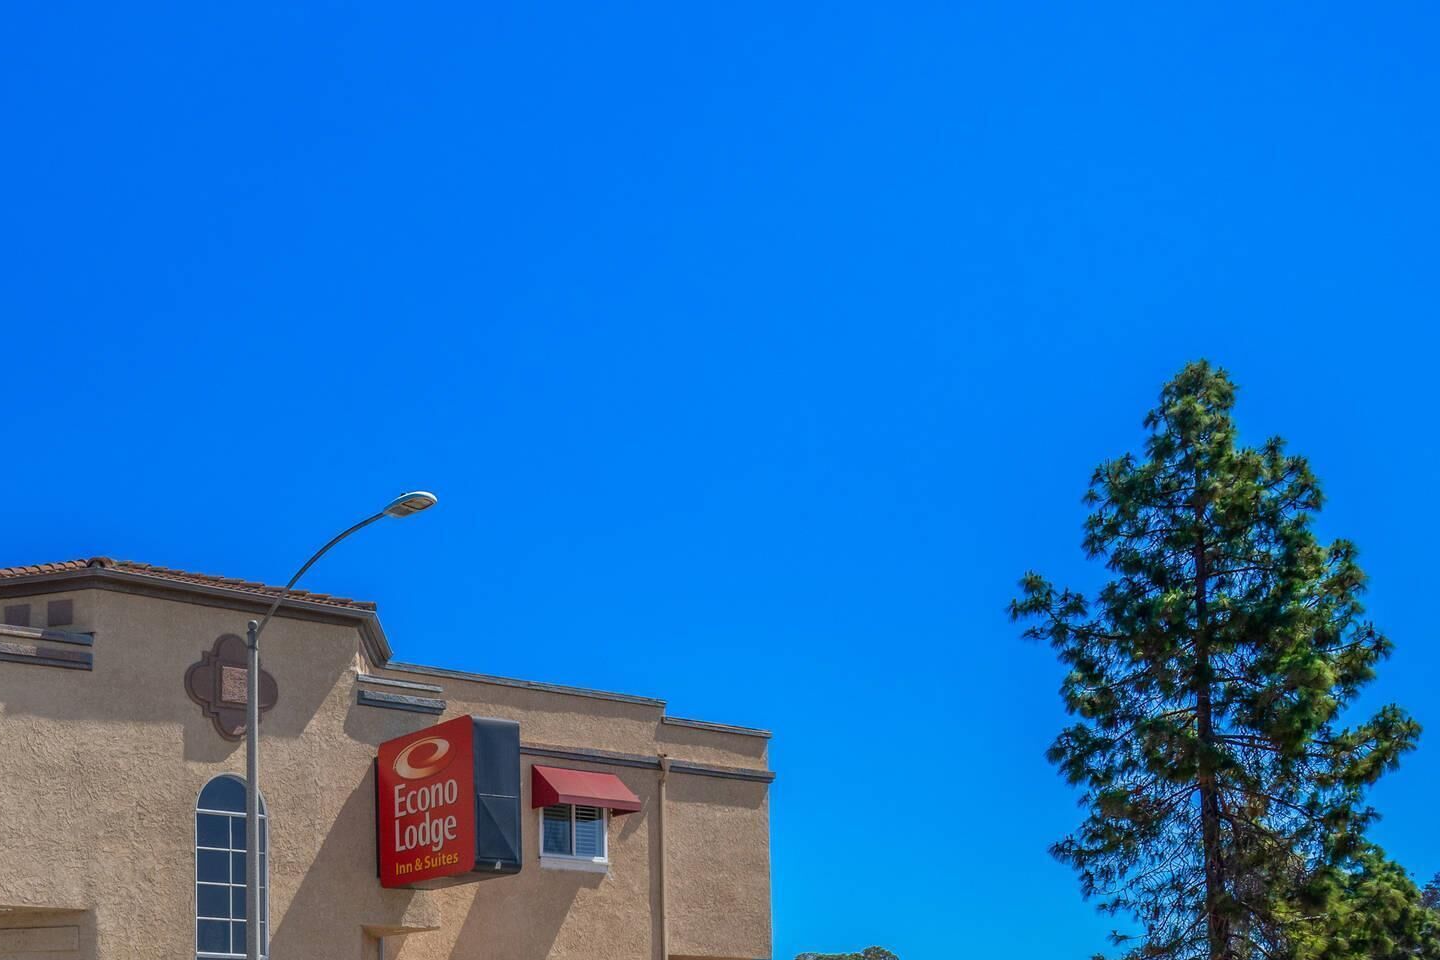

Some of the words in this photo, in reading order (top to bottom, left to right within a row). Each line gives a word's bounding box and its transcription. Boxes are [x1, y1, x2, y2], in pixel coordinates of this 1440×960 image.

[394, 779, 458, 818] Econo
[394, 811, 457, 852] Lodge
[395, 862, 413, 876] Inn
[414, 857, 423, 871] &
[424, 852, 459, 869] Suites
